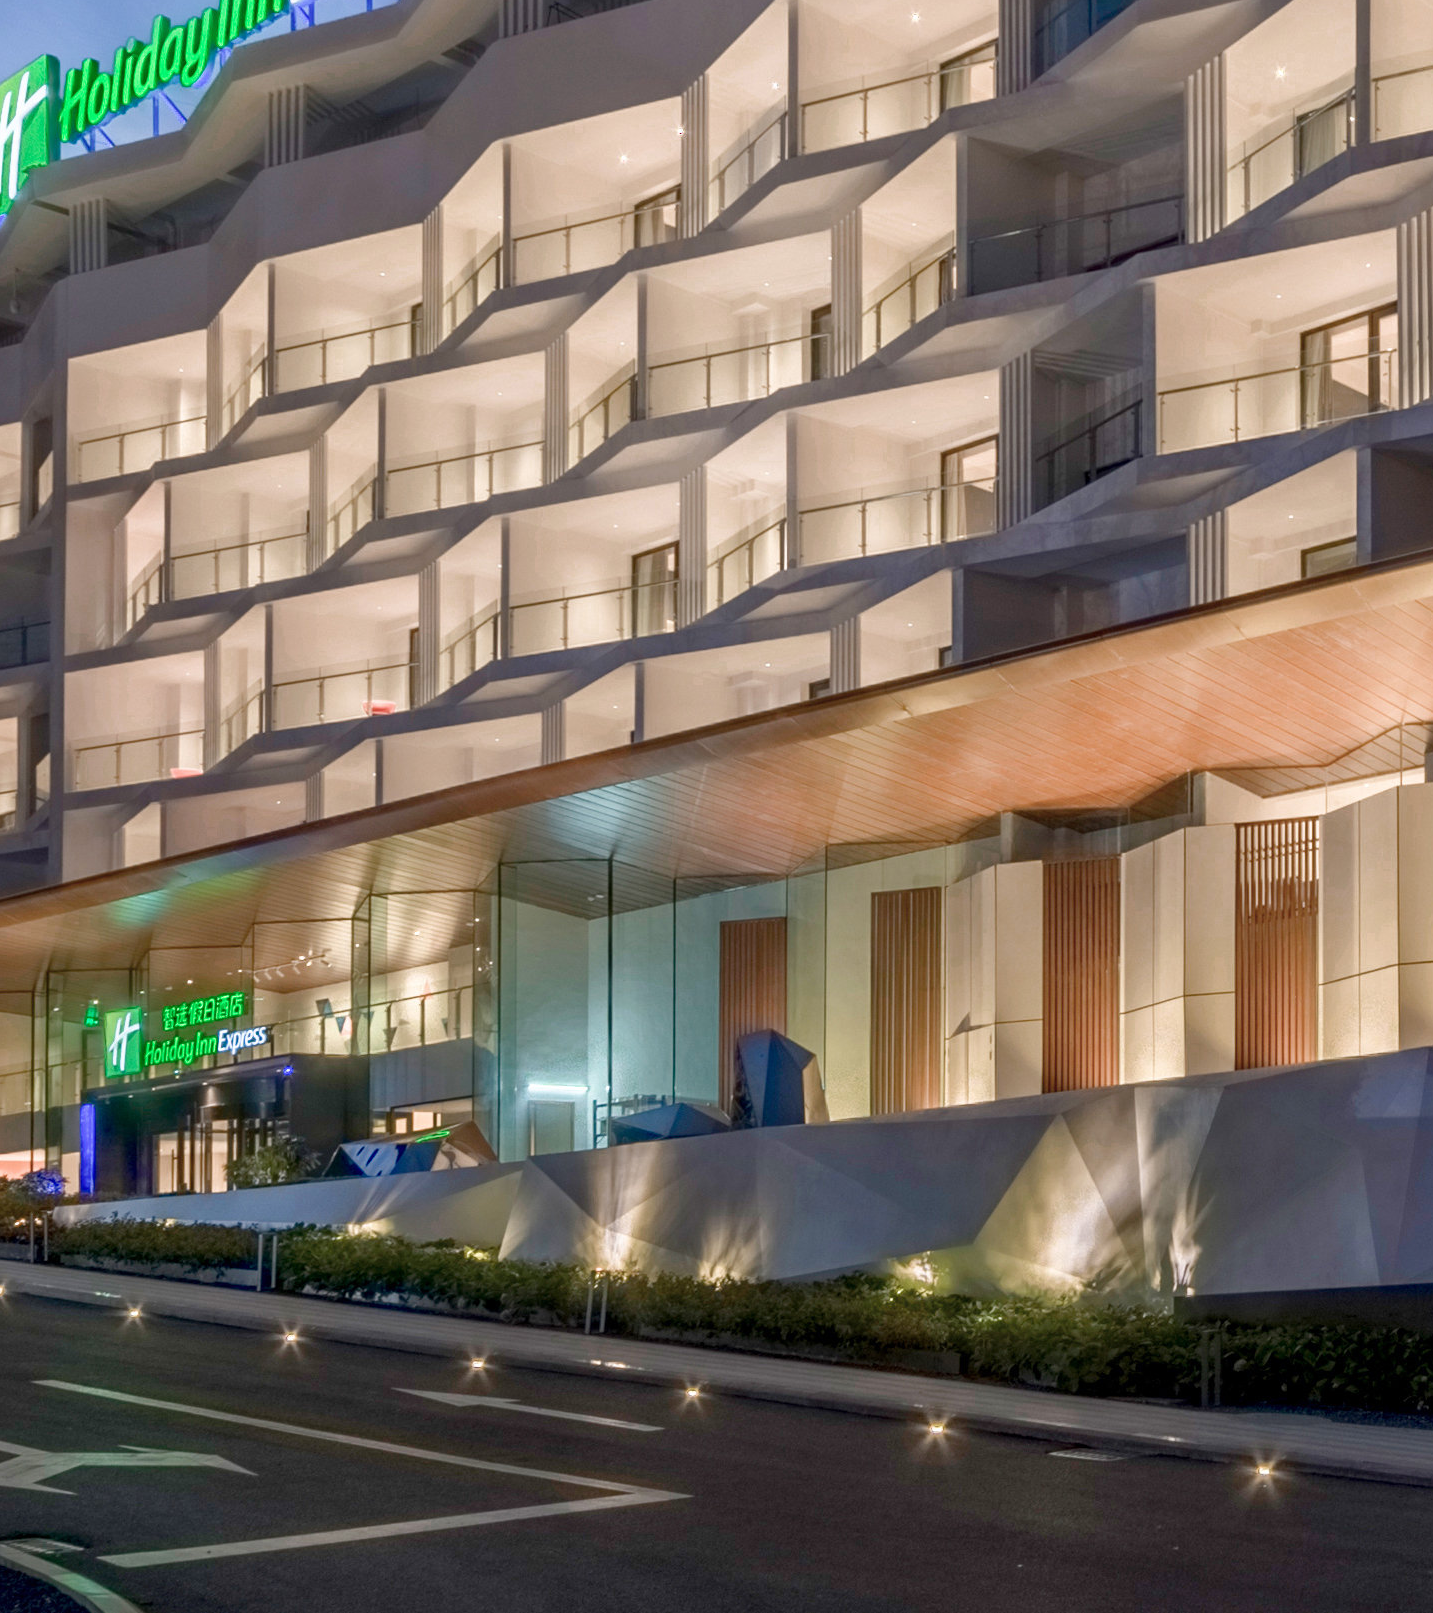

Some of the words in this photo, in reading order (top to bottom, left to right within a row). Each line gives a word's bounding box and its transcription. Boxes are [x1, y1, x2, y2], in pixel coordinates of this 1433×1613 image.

[59, 6, 215, 143] Holiday
[162, 992, 244, 1032] 智选假日酒店
[144, 1033, 194, 1066] Holiday
[196, 1031, 217, 1057] Inn
[217, 1026, 268, 1056] Express
